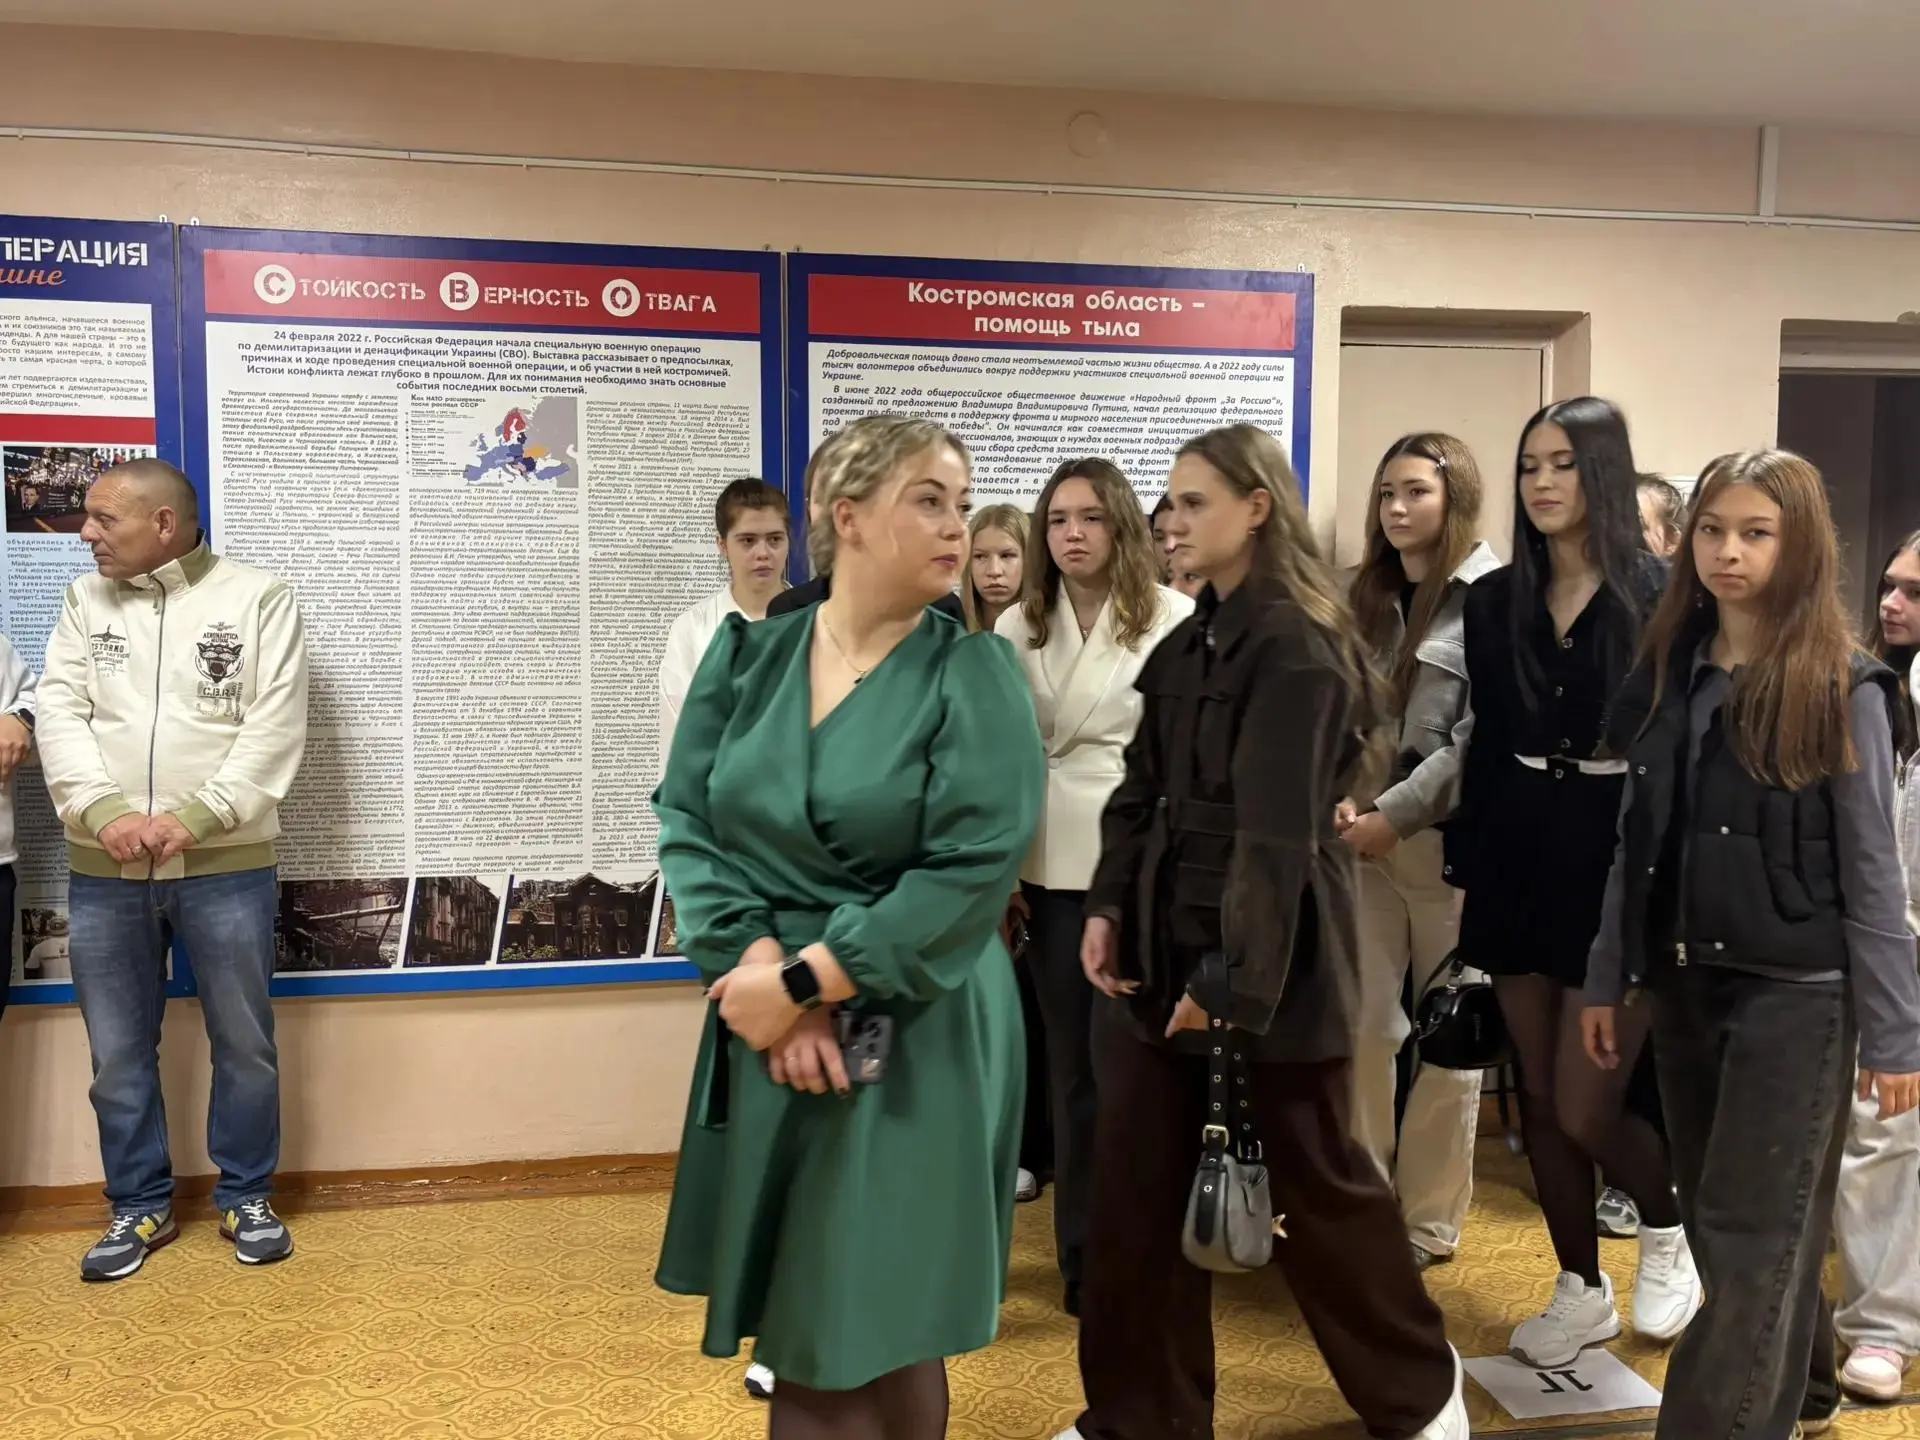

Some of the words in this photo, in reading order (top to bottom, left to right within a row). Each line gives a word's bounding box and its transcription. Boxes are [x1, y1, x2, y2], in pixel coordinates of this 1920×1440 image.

[0, 269, 66, 285] ине
[908, 282, 1075, 310] Костромская
[1085, 290, 1183, 312] область
[975, 317, 1071, 337] помощь
[1082, 320, 1140, 337] тыла
[273, 330, 286, 339] 24
[288, 330, 334, 343] февраля
[337, 332, 362, 342] 2022
[374, 333, 432, 344] Российская
[434, 335, 493, 348] Федерация
[495, 339, 531, 347] начала
[533, 340, 601, 352] специальную
[603, 343, 648, 353] военную
[649, 344, 701, 355] операцию
[237, 342, 251, 350] по
[253, 343, 352, 355] демилитаризации
[362, 344, 448, 358] денацификации
[450, 347, 496, 360] Украины
[498, 348, 530, 361] (СВО).
[532, 350, 579, 360] Выставка
[582, 353, 649, 365] рассказывает
[660, 356, 734, 367] предпосылках,
[827, 349, 910, 362] Добровольческая
[911, 354, 950, 363] помощь
[951, 353, 980, 362] давно
[1012, 355, 1084, 365] неотъемлемой
[1122, 360, 1152, 369] жизни
[1203, 361, 1210, 369] А
[1211, 361, 1217, 369] в
[1218, 361, 1239, 370] 2022
[1240, 362, 1261, 373] году
[241, 354, 292, 365] причинах
[304, 356, 330, 366] ходе
[332, 357, 395, 368] проведения
[398, 357, 466, 370] специальной
[468, 359, 512, 369] военной
[514, 362, 568, 373] операции,
[579, 362, 592, 372] об
[593, 365, 633, 375] участии
[643, 364, 662, 374] ней
[663, 365, 730, 378] костромичей.
[246, 364, 284, 374] Истоки
[287, 365, 344, 378] конфликта
[346, 369, 378, 377] лежат
[380, 368, 421, 380] глубоко
[432, 371, 484, 382] прошлом.
[486, 371, 507, 383] Для
[524, 374, 582, 383] понимания
[584, 374, 646, 387] необходимо
[648, 378, 676, 386] знать
[677, 378, 726, 387] основные
[856, 361, 914, 373] волонтеров
[916, 363, 982, 373] объединились
[985, 365, 1016, 376] вокруг
[1018, 366, 1070, 378] поддержки
[1072, 367, 1127, 379] участников
[1129, 369, 1187, 381] специальной
[1188, 371, 1226, 380] военной
[1228, 374, 1270, 383] операции
[396, 380, 440, 390] события
[442, 383, 497, 394] последних
[499, 384, 537, 392] восьми
[539, 383, 587, 394] столетий.
[833, 385, 840, 393] В
[873, 386, 896, 395] 2022
[900, 387, 922, 396] года
[926, 387, 1002, 400] общероссийское
[1006, 390, 1076, 402] общественное
[1079, 392, 1125, 401] движение
[1129, 393, 1181, 404] «Народный
[1184, 394, 1216, 405] фронт
[821, 395, 874, 407] созданный
[891, 397, 958, 409] предложению
[961, 399, 1013, 411] Владимира
[1016, 400, 1088, 412] Владимировича
[1162, 406, 1217, 416] реализацию
[1220, 406, 1283, 418] федерального
[822, 408, 864, 417] проекта
[950, 409, 956, 418] в
[958, 410, 1010, 421] поддержку
[1011, 411, 1050, 422] фронта
[1059, 414, 1099, 423] мирного
[1100, 415, 1148, 423] населения
[1149, 414, 1223, 426] присоединенных
[822, 418, 840, 426] под
[996, 422, 1012, 430] Он
[1087, 424, 1143, 433] совместная
[988, 443, 1015, 454] сбора
[1016, 444, 1054, 454] средств
[1055, 446, 1099, 455] захотели
[1108, 445, 1149, 454] обычные
[1015, 435, 1058, 444] знающих
[1066, 434, 1102, 445] нуждах
[1102, 435, 1142, 444] военных
[974, 453, 1042, 463] командование
[1137, 456, 1170, 467] фронт
